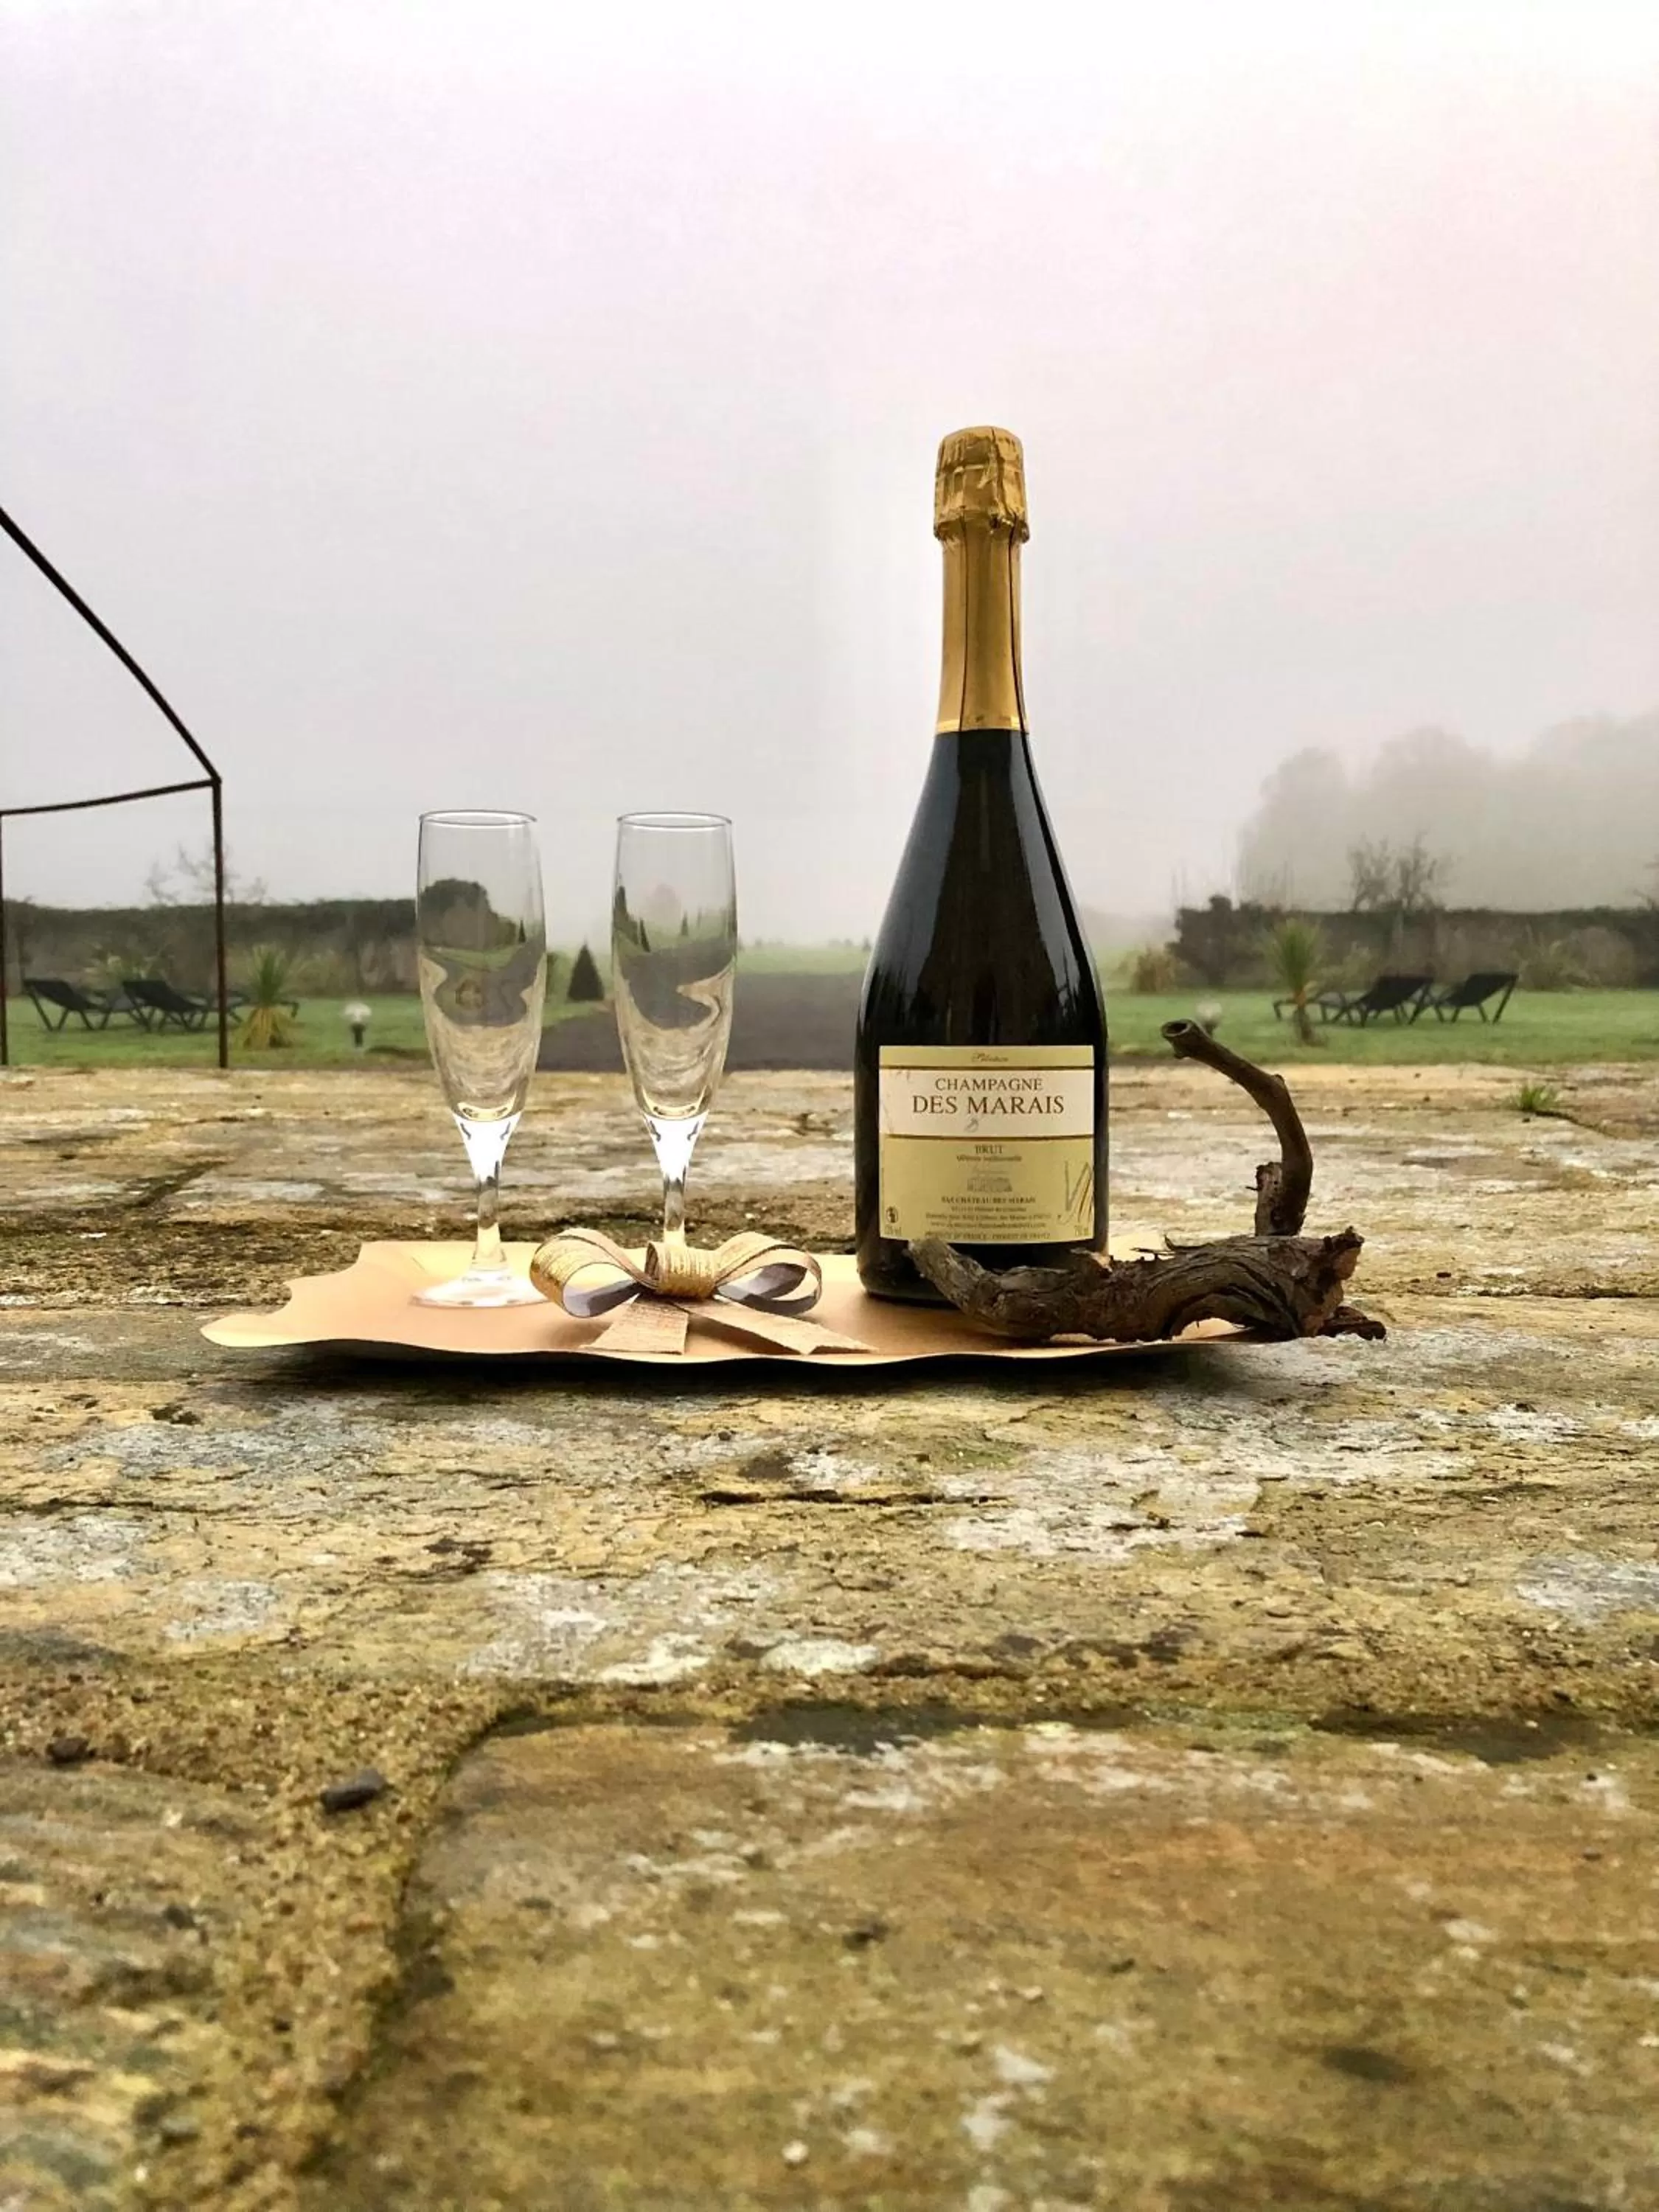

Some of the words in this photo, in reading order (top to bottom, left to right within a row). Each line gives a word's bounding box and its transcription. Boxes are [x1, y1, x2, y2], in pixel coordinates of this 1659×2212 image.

[935, 1077, 1043, 1091] CHAMPAGNE
[912, 1095, 958, 1114] DES
[967, 1095, 1065, 1114] MARAIS
[974, 1144, 1004, 1154] BRUT
